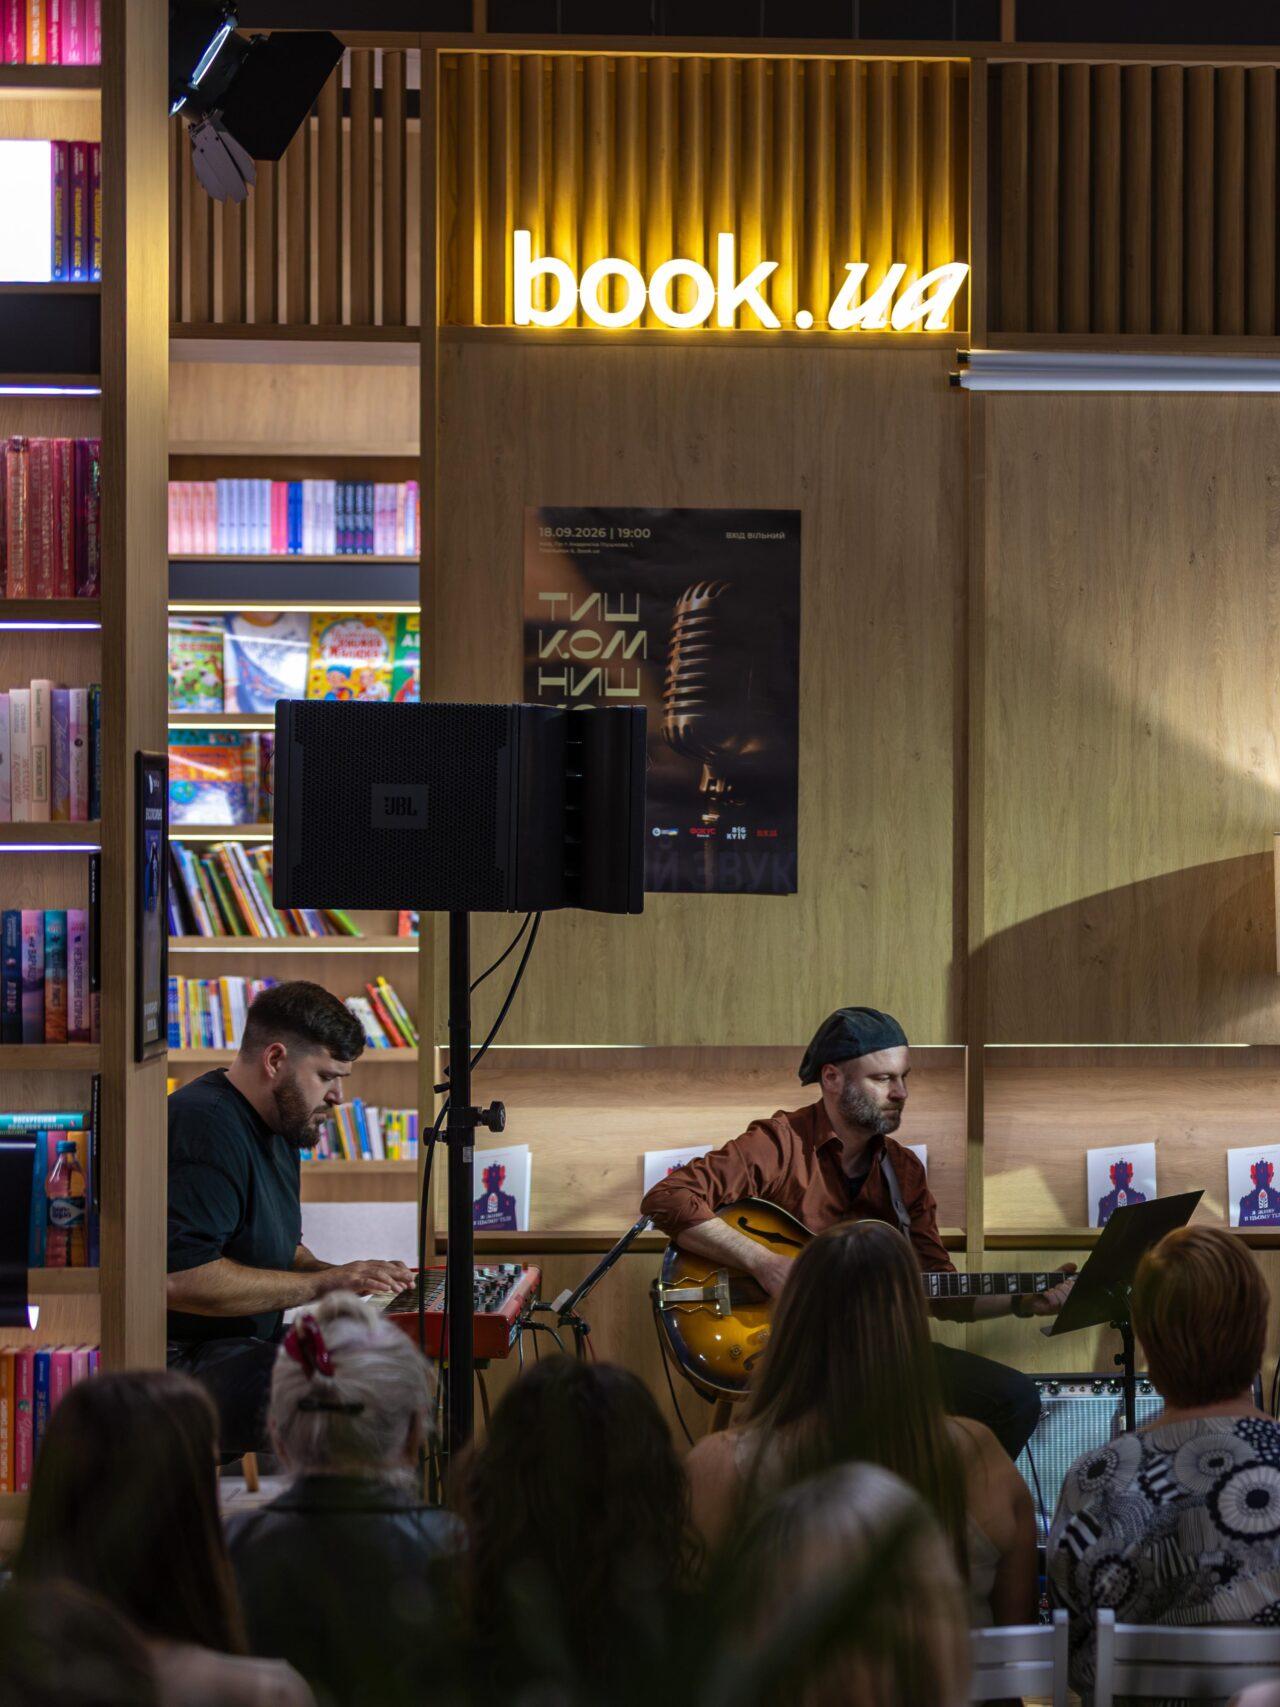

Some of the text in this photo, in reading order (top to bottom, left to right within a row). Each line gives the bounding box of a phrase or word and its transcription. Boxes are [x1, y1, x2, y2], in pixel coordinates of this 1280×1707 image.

[513, 229, 970, 330] book.ua
[538, 527, 607, 538] 18.09.2026
[617, 527, 651, 539] 19:00
[538, 592, 640, 621] ТИШ
[538, 629, 648, 660] КОМ
[538, 667, 641, 697] НИШ
[384, 796, 419, 816] JBL
